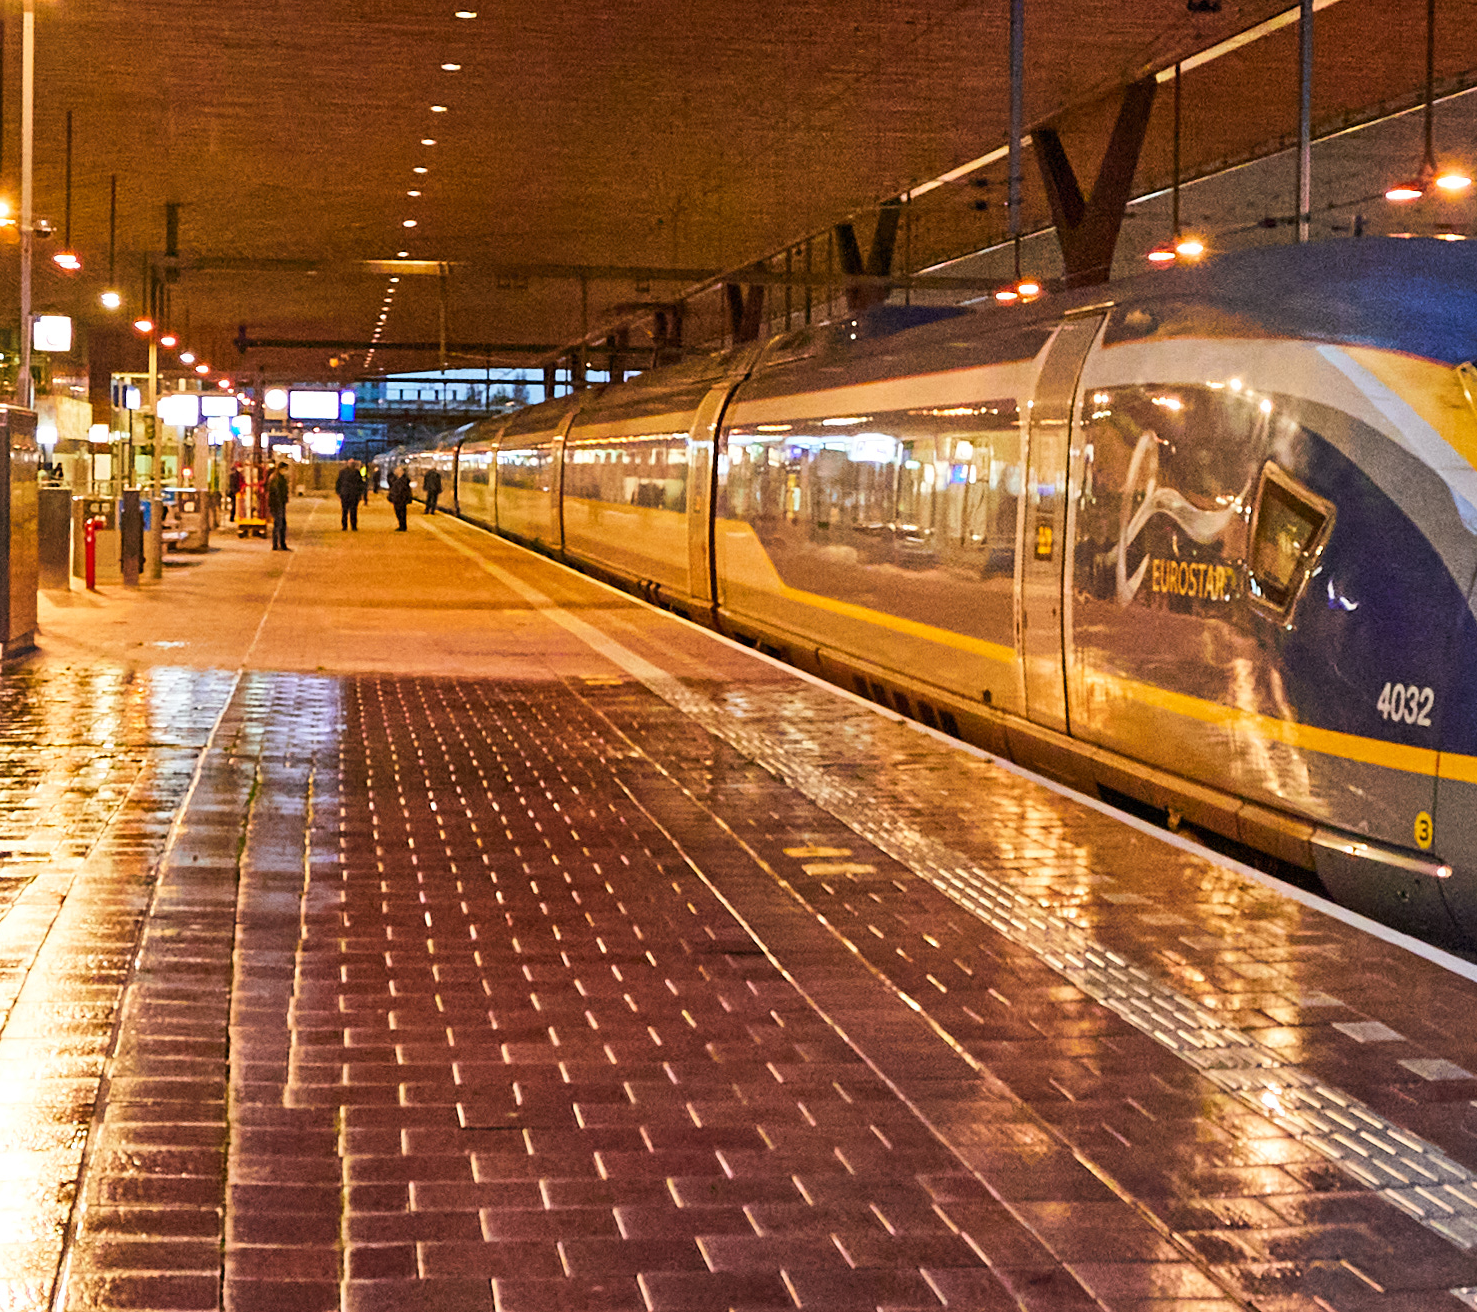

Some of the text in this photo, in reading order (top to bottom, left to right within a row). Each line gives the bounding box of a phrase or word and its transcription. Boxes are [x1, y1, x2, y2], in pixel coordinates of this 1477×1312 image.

[1152, 558, 1227, 601] EUROSTAR
[1376, 682, 1435, 727] 4032
[1419, 819, 1430, 841] 3
